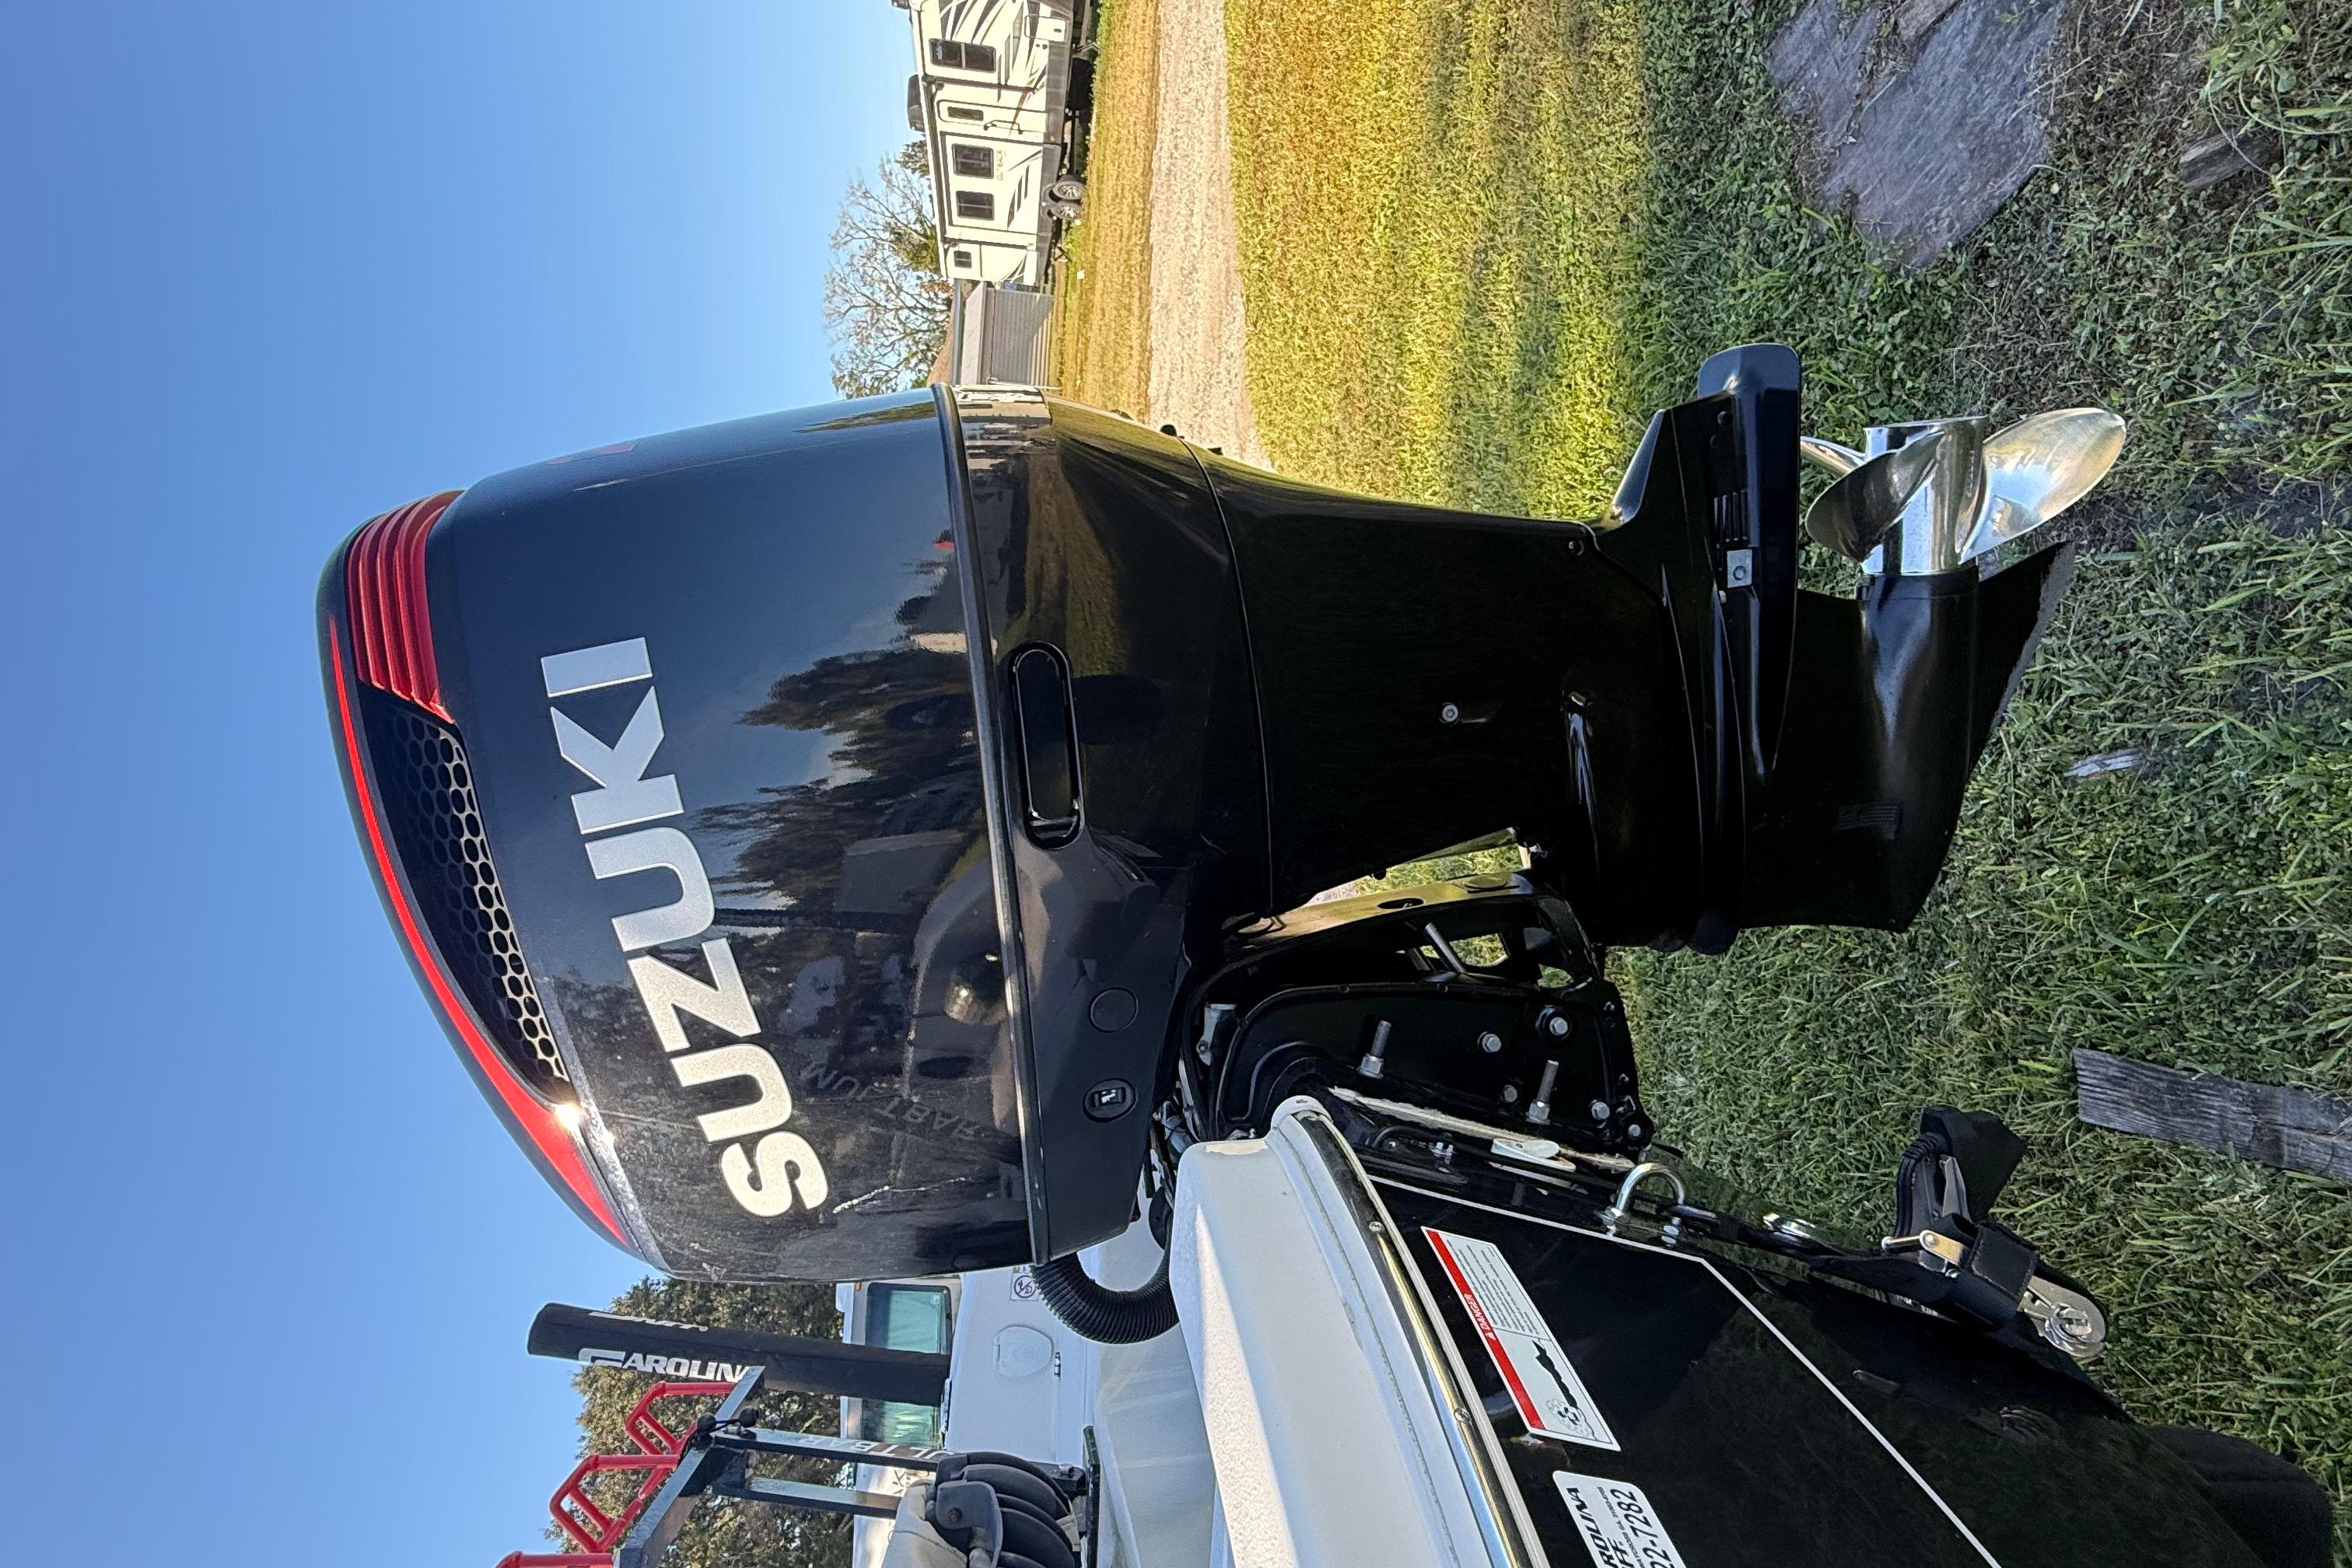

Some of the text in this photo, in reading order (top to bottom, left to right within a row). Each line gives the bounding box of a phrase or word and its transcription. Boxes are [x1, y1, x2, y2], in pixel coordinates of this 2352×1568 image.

[541, 636, 830, 1217] SUZUKI
[1464, 1293, 1491, 1330] DANGER
[578, 1348, 750, 1383] CAROLIN
